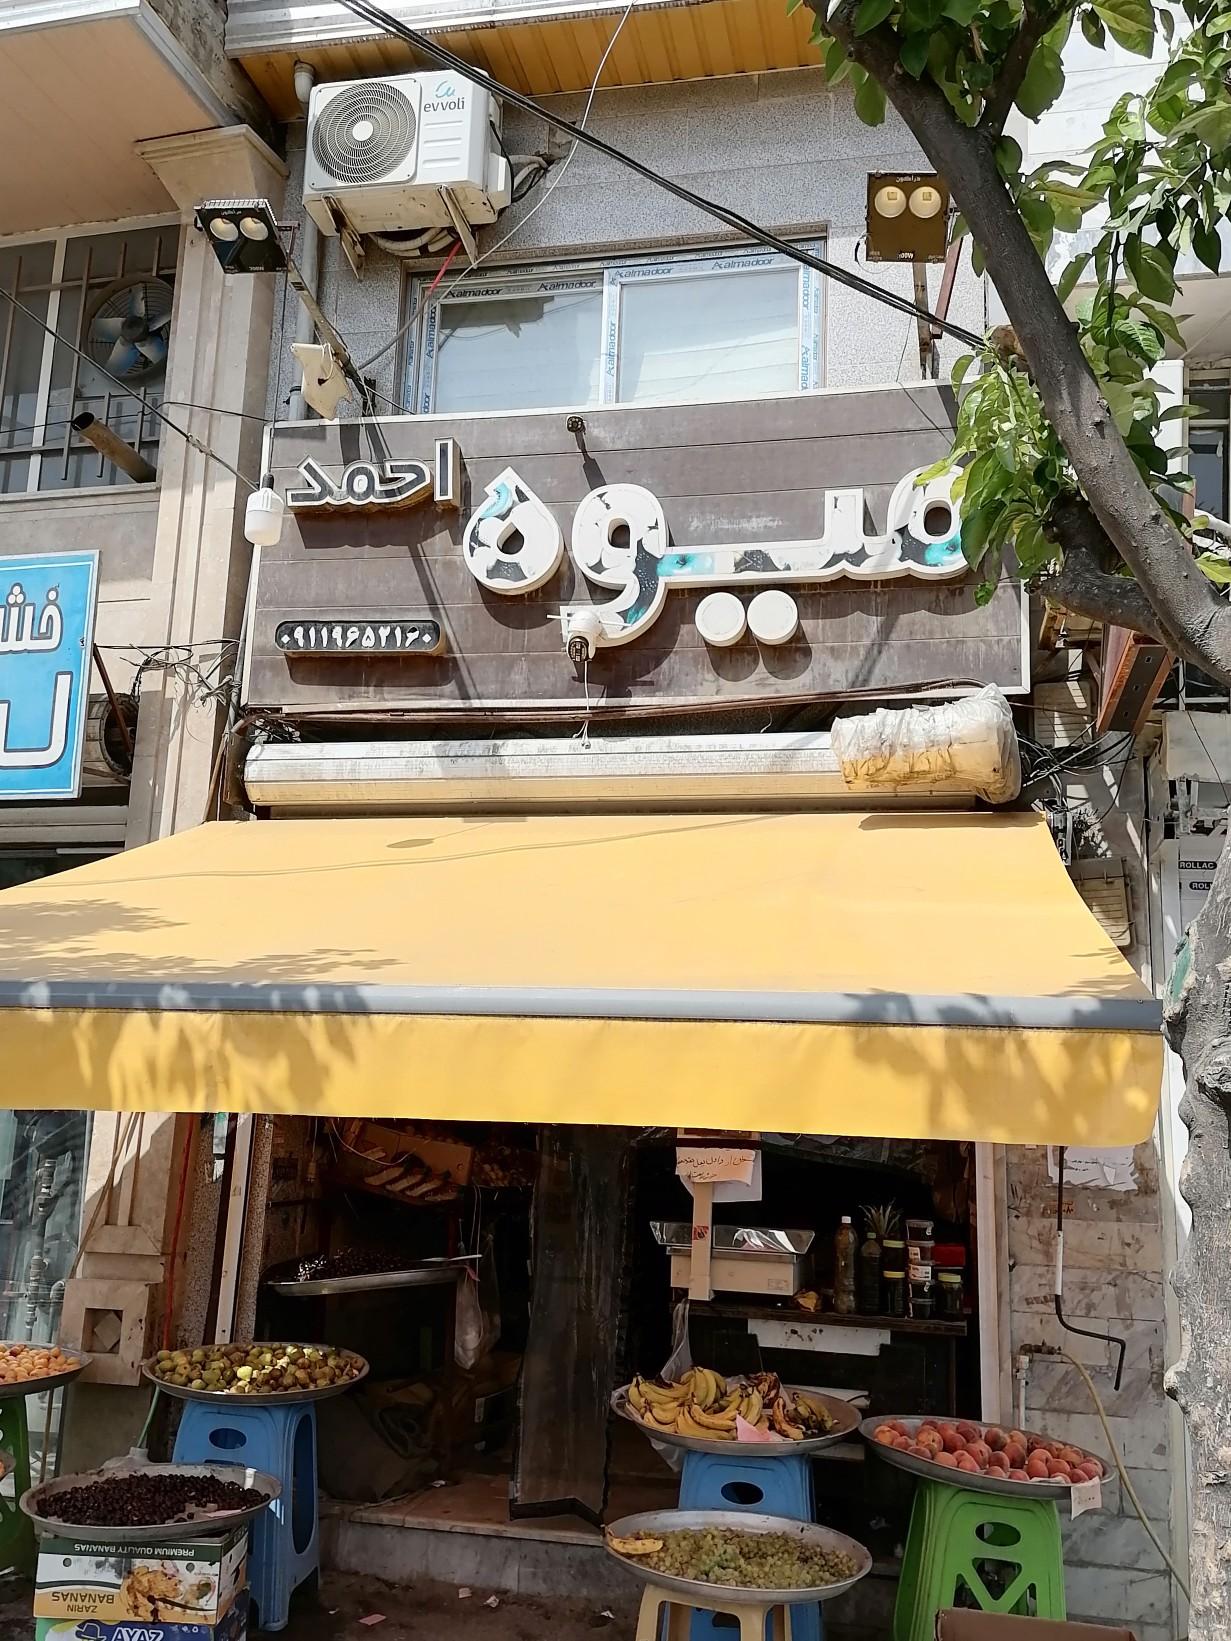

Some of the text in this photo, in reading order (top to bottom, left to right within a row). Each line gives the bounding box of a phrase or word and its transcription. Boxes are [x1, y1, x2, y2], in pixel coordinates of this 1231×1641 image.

[423, 96, 465, 113] evvoli
[285, 437, 455, 507] احمد
[1191, 882, 1211, 890] ROL
[74, 1543, 195, 1557] PREMIUM QUALITY BANANAS
[51, 1591, 115, 1604] BANANAS
[66, 1604, 98, 1614] ZARIN
[112, 1627, 164, 1641] AYAZ
